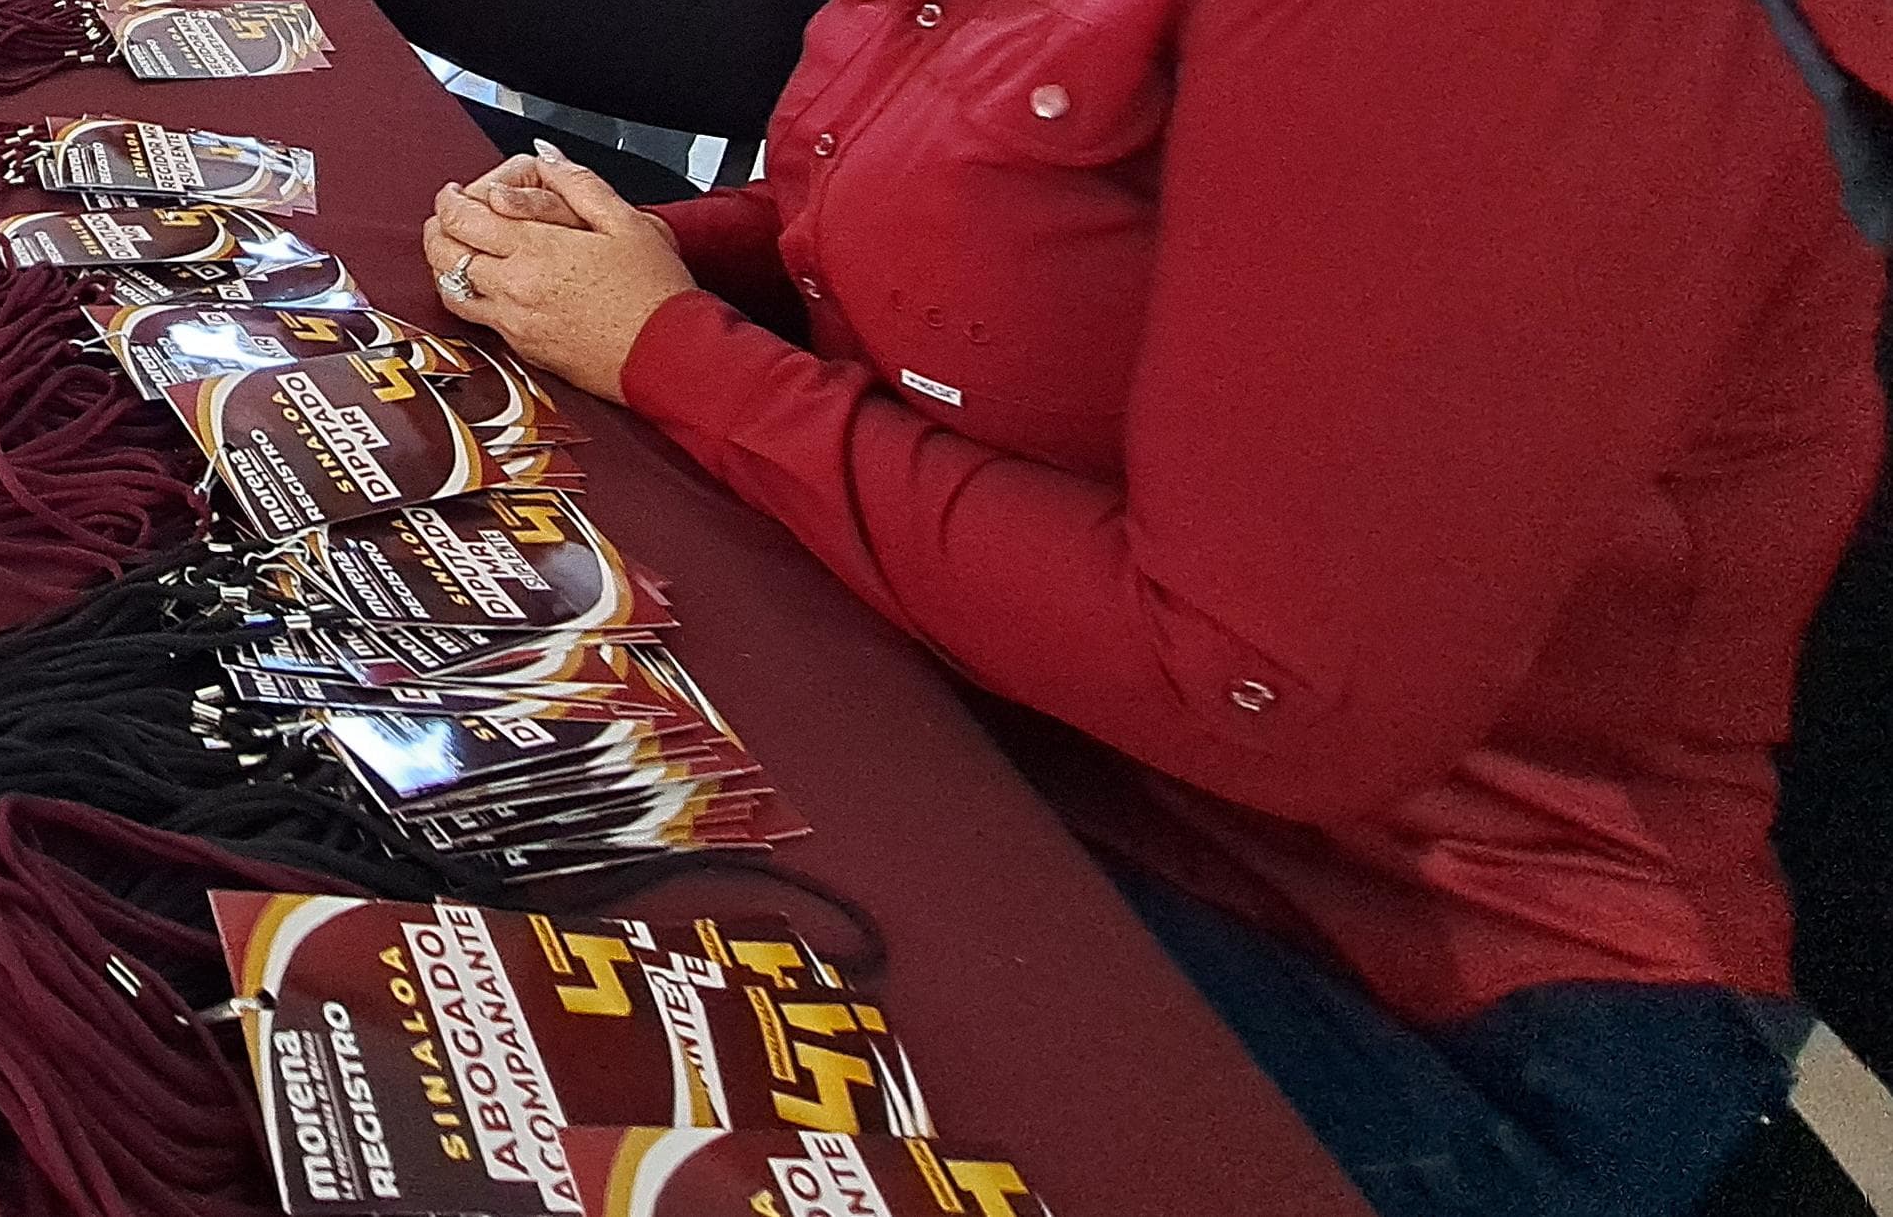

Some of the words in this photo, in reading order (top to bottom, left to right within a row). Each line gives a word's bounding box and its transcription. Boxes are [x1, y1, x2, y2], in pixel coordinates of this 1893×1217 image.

[124, 133, 148, 179] SINALOA
[149, 141, 176, 190] REGIDOR
[167, 134, 196, 185] SUPLENTE
[122, 264, 174, 299] REGIST
[272, 391, 354, 493] SINALOA
[286, 376, 391, 497] DIPUTADO
[340, 409, 378, 446] MR
[229, 449, 293, 531] morena
[250, 429, 325, 522] REGISTRO
[331, 550, 392, 617] morena
[359, 540, 431, 619] REGISTRO
[391, 519, 471, 607] SINALOA
[411, 509, 513, 616] DIPUTADO
[468, 544, 508, 577] MR
[378, 945, 474, 1163] SINALOA
[412, 928, 521, 1176] ABOGADO
[449, 907, 578, 1206] ACOMPAÑANTE
[275, 1030, 341, 1200] morena
[322, 1000, 400, 1199] REGISTRO
